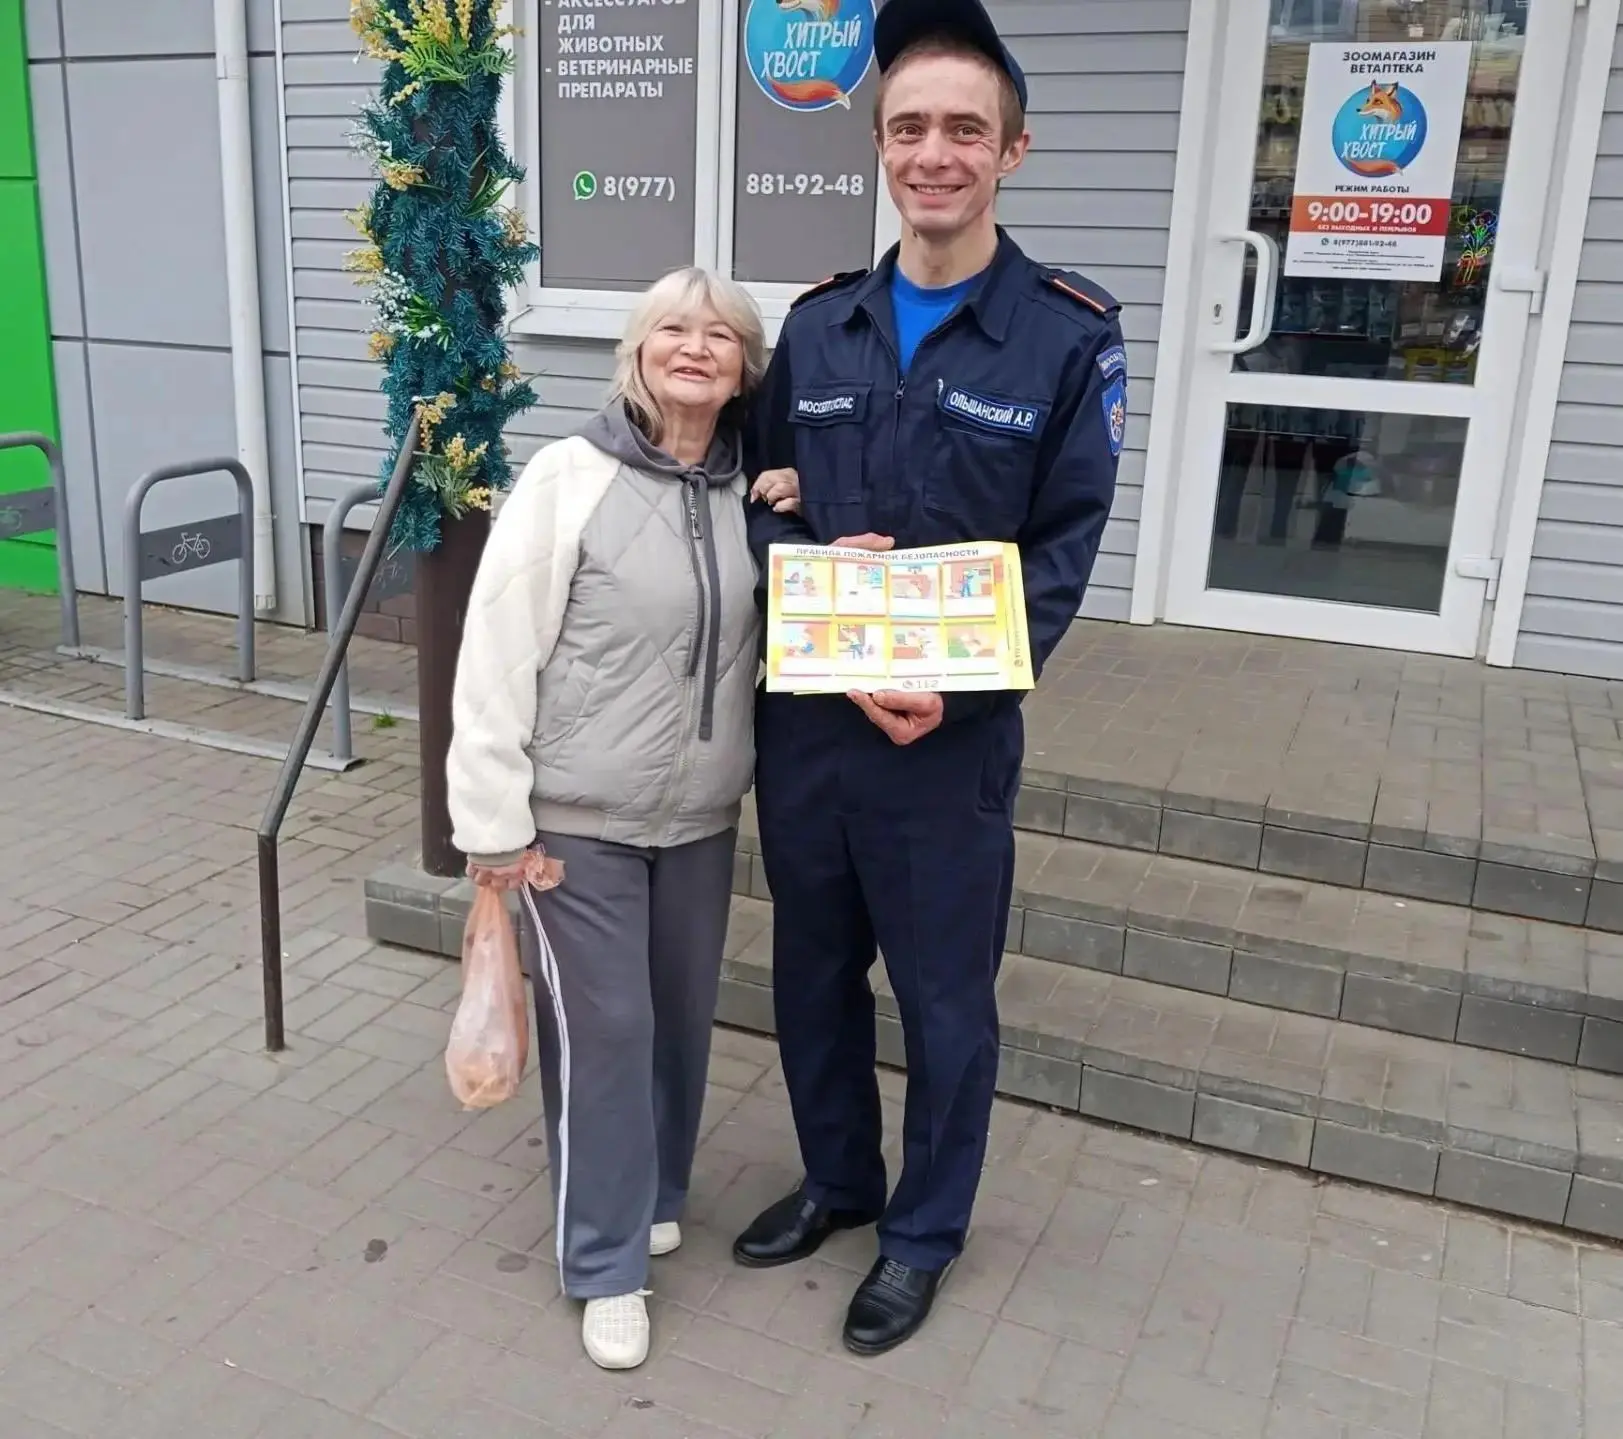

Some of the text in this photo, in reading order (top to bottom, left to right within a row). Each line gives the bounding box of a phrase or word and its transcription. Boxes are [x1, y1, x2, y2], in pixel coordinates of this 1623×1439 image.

[557, 14, 595, 34] ДЛЯ
[783, 15, 862, 49] ХИТРЫЙ
[558, 35, 665, 54] ЖИВОТНЫХ
[760, 50, 822, 79] ХВОСТ
[1342, 51, 1436, 62] ЗООМАГАЗИН
[557, 57, 693, 77] ВЕТЕРИНАРНЫЕ
[1350, 63, 1424, 74] ВЕТАПТЕКА
[558, 81, 664, 99] ПРЕПАРАТЫ
[1359, 120, 1417, 141] ХИТРЫЙ
[1340, 142, 1387, 159] ХВОСТ
[603, 174, 865, 202] 8(977) 881-92-48
[1370, 185, 1410, 193] РАБОТЫ
[1307, 201, 1432, 225] 9:00-19:00
[949, 391, 1014, 424] ОЛЬШАНСКИЙ
[796, 548, 841, 556] ПРАВИЛА
[901, 549, 979, 560] БЕЗОПАСНОСТИ
